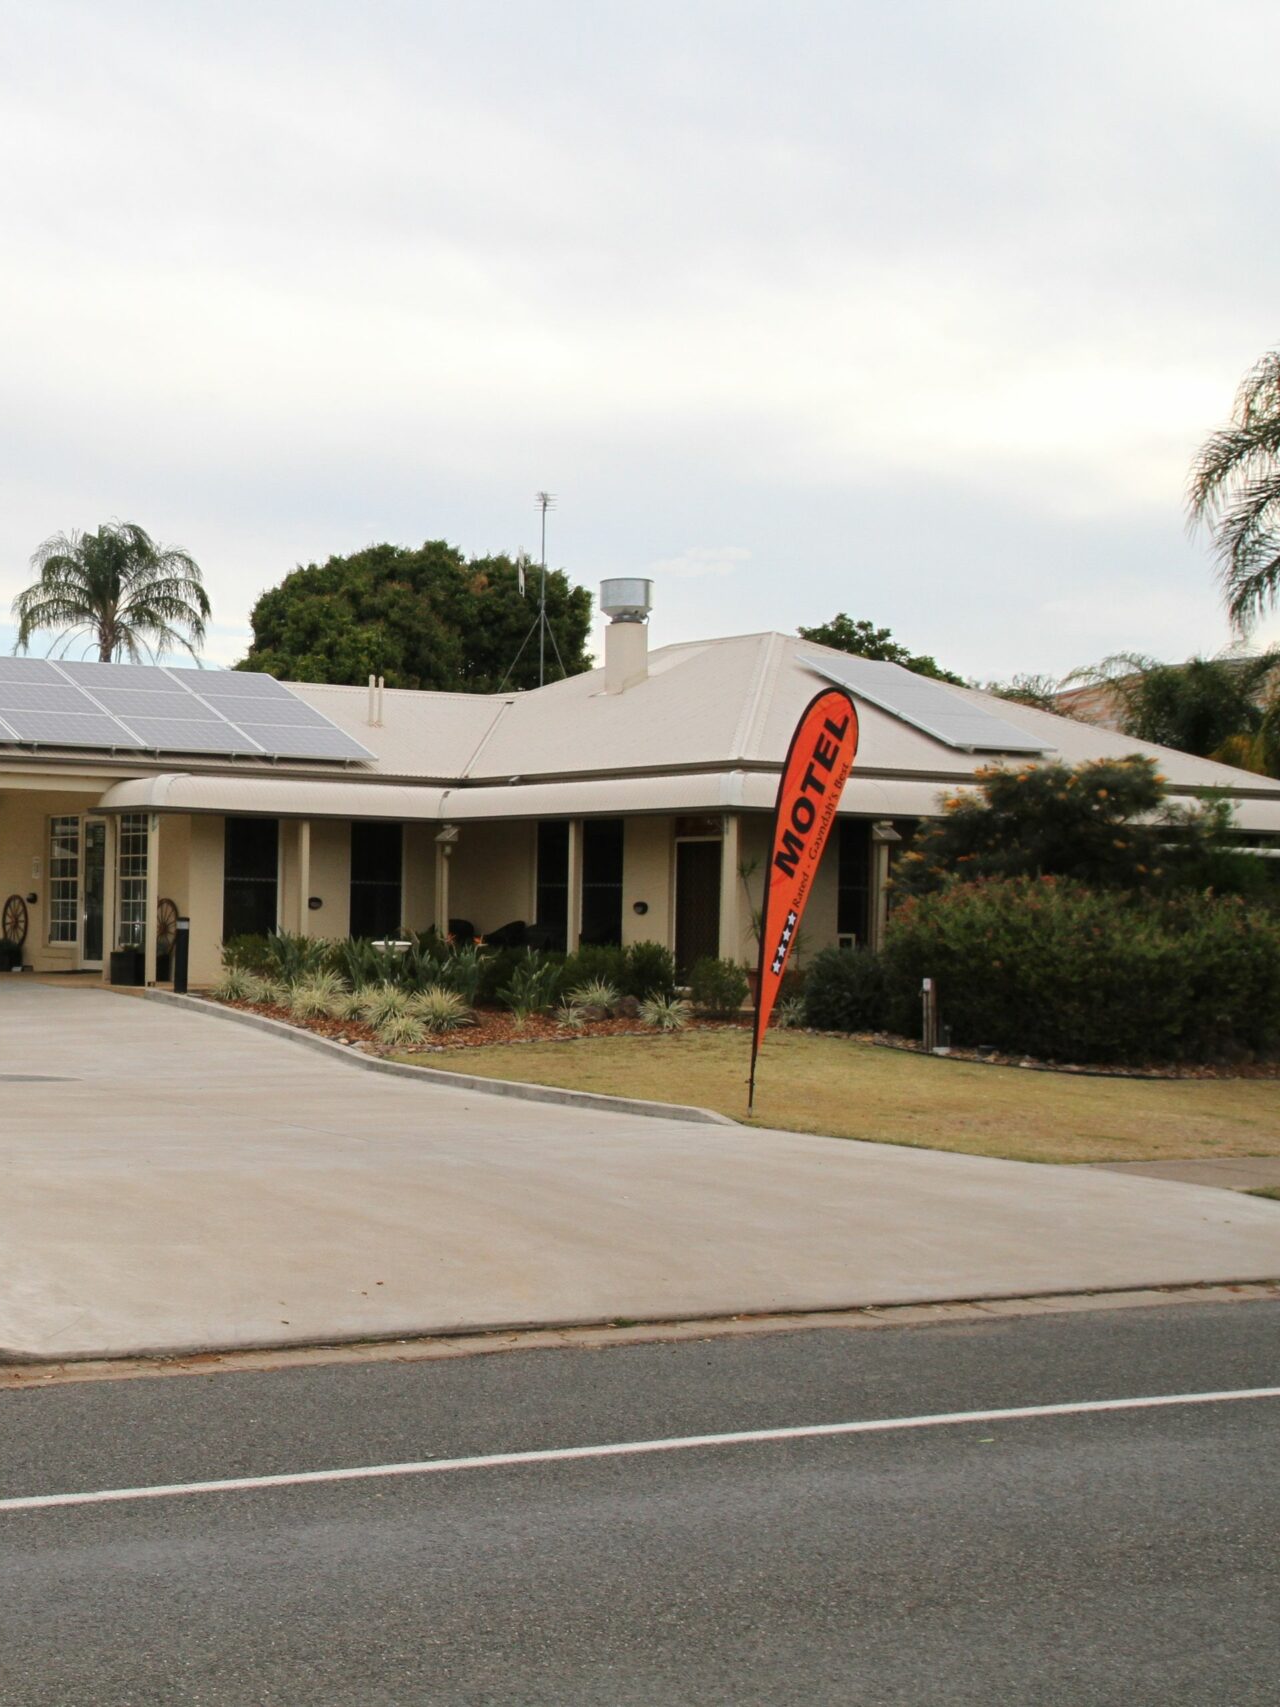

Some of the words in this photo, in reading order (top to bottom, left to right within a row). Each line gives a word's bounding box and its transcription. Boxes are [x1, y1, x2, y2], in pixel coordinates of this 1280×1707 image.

[774, 715, 849, 879] MOTEL
[792, 871, 810, 909] Rated
[808, 793, 839, 860] Gayndah's
[833, 762, 850, 790] Best
